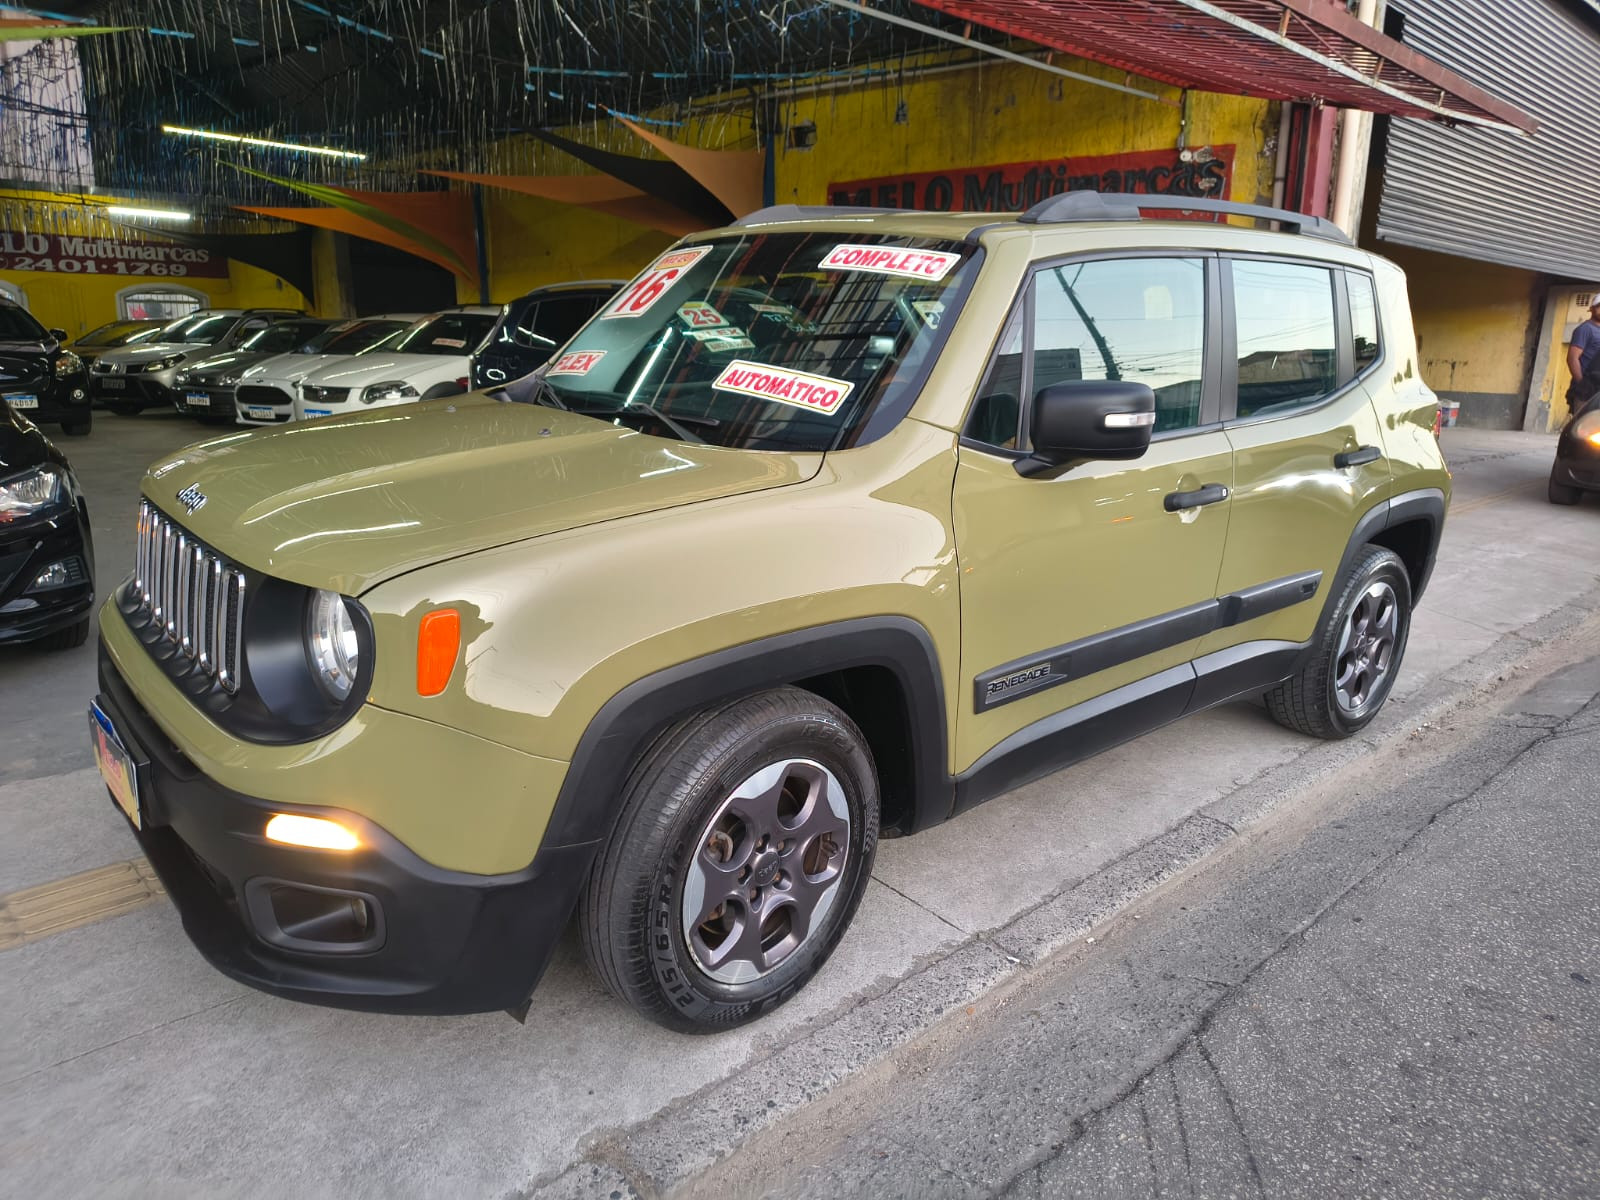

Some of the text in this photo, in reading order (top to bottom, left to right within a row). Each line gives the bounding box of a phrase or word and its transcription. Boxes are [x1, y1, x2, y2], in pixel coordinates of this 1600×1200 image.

[963, 158, 1226, 212] Multimarcas
[0, 232, 209, 263] LO Multimarcas
[829, 248, 947, 275] COMPLETO
[614, 268, 680, 312] 16
[682, 308, 722, 326] 25
[555, 354, 601, 371] FLEX
[720, 368, 840, 408] AUTOMÁTICO
[986, 665, 1051, 696] RENEGADE
